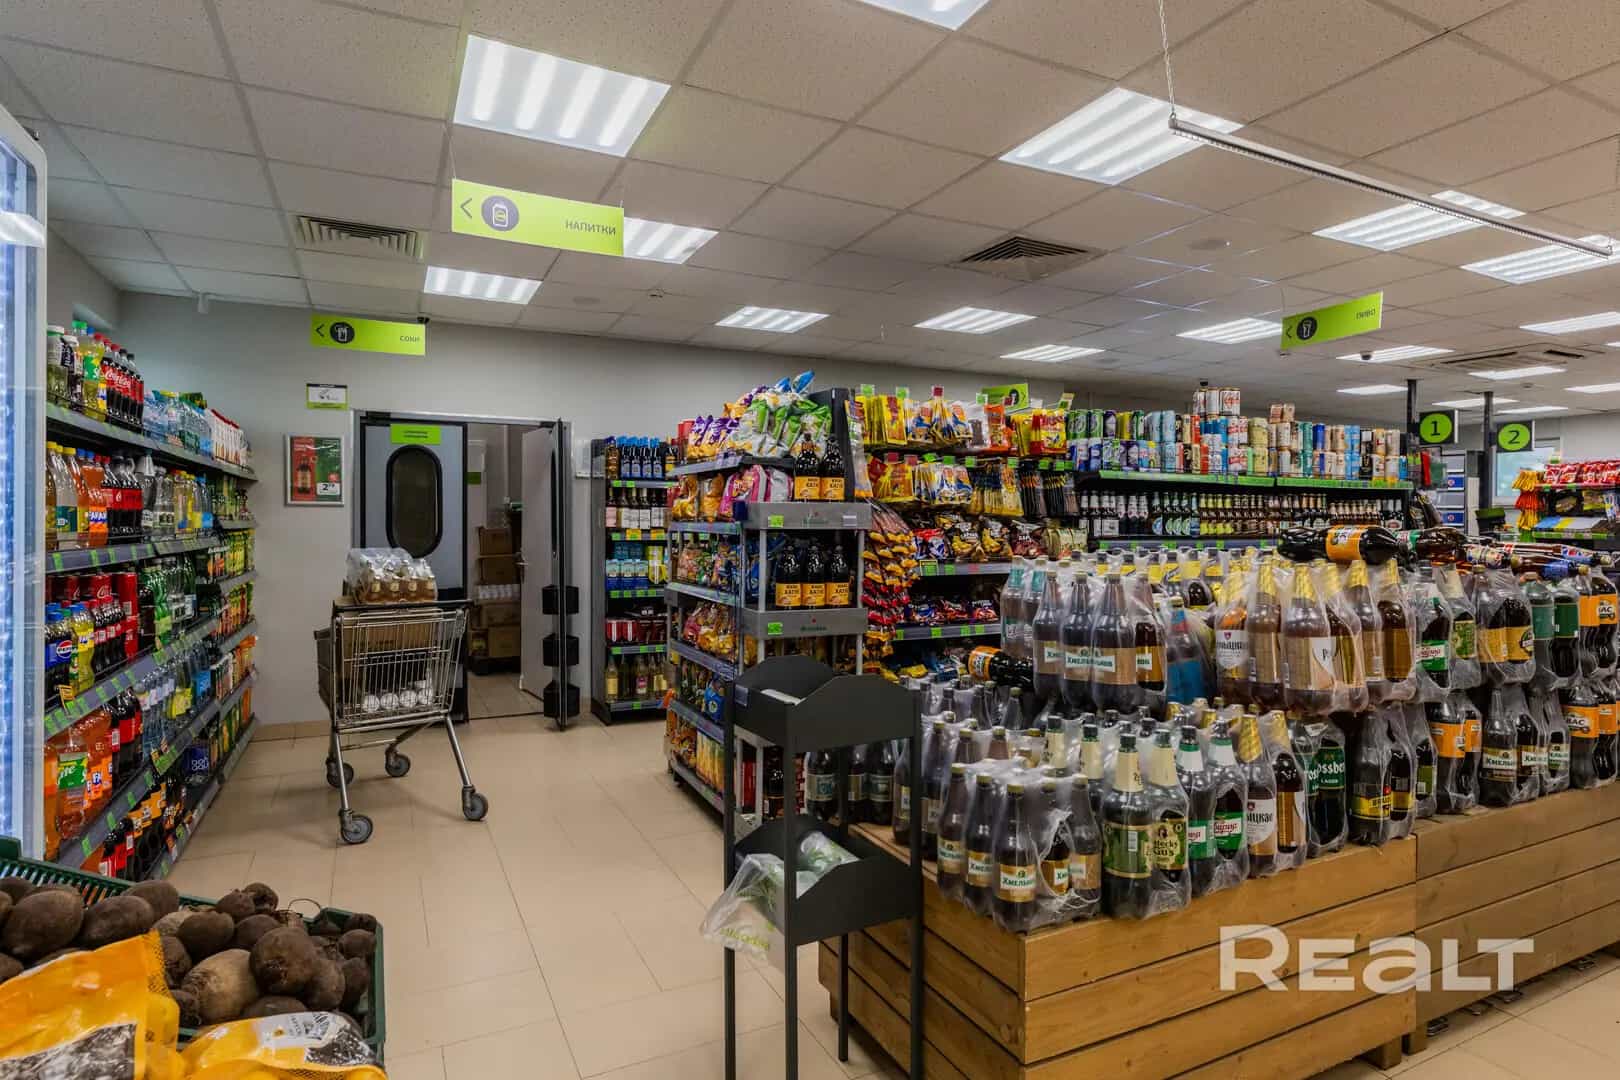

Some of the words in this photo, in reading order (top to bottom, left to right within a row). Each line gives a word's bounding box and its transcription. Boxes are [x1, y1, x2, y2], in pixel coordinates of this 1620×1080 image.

[565, 220, 616, 236] НАПИТКИ
[1430, 420, 1441, 436] 1
[1508, 430, 1520, 444] 2
